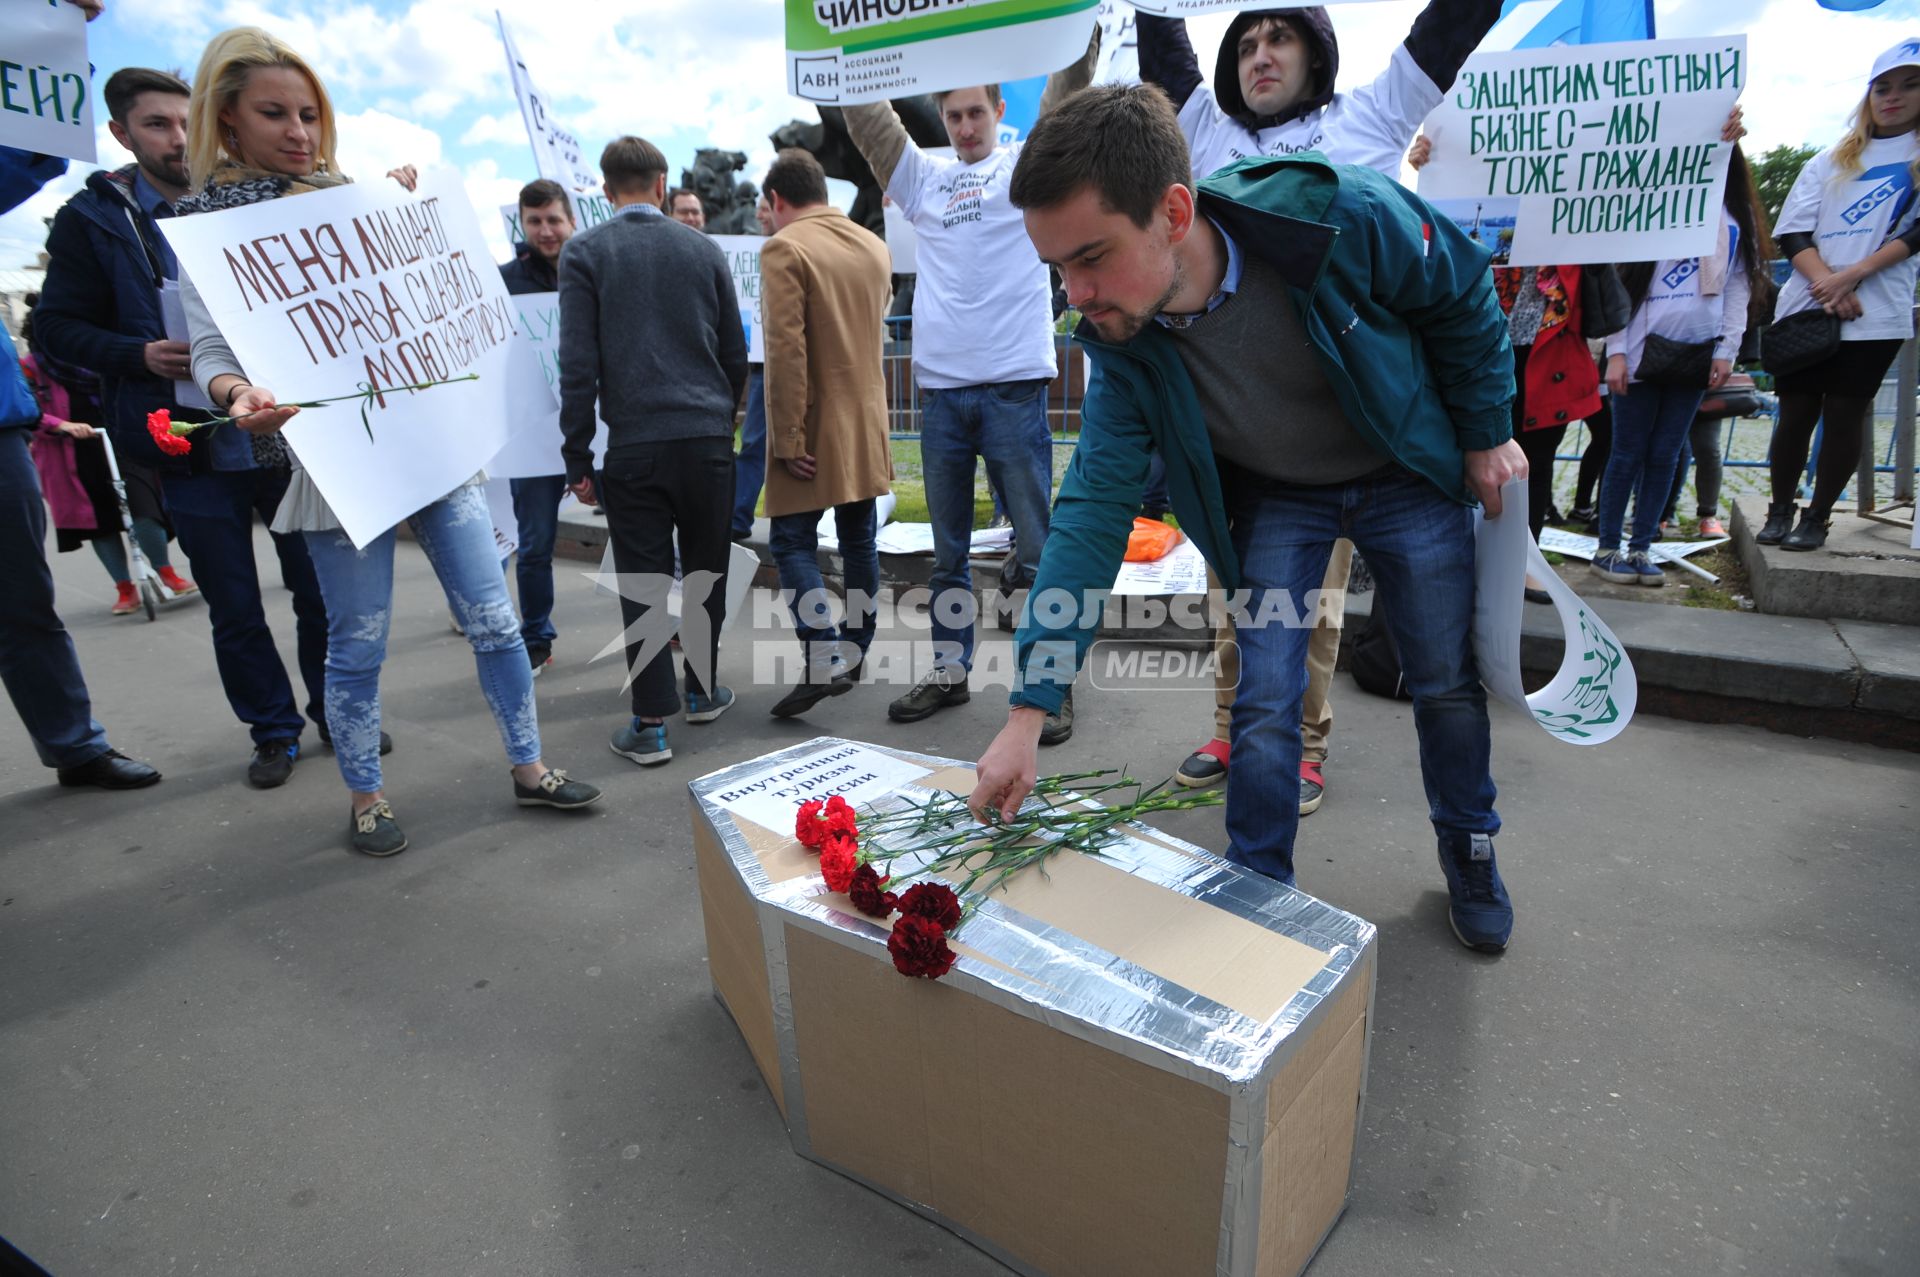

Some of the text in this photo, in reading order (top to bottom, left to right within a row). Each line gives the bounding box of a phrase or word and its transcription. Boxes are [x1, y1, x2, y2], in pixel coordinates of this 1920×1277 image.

[845, 52, 903, 69] АССОЦИАЦИЯ
[845, 66, 901, 82] ВЛАДЕЛЬЦЕВ
[1457, 47, 1740, 111] ЗАЩИТИМ ЧЕСТНЫЙ
[846, 77, 918, 95] НЕДВИЖИМОСТИ
[1470, 109, 1576, 155] БИЗНЕС
[1483, 143, 1718, 195] ТОЖЕ ГРАЖДАНЕ
[942, 211, 982, 229] БИЗНЕС
[1845, 181, 1896, 222] РОСТ
[223, 197, 450, 311] МЕНЯ ЛИШАЮТ
[286, 280, 416, 365] ПРАВА
[404, 249, 483, 325] СДАВАТЬ
[363, 331, 449, 409] МОЮ
[719, 746, 861, 803] Внутренний
[772, 764, 856, 799] туризм
